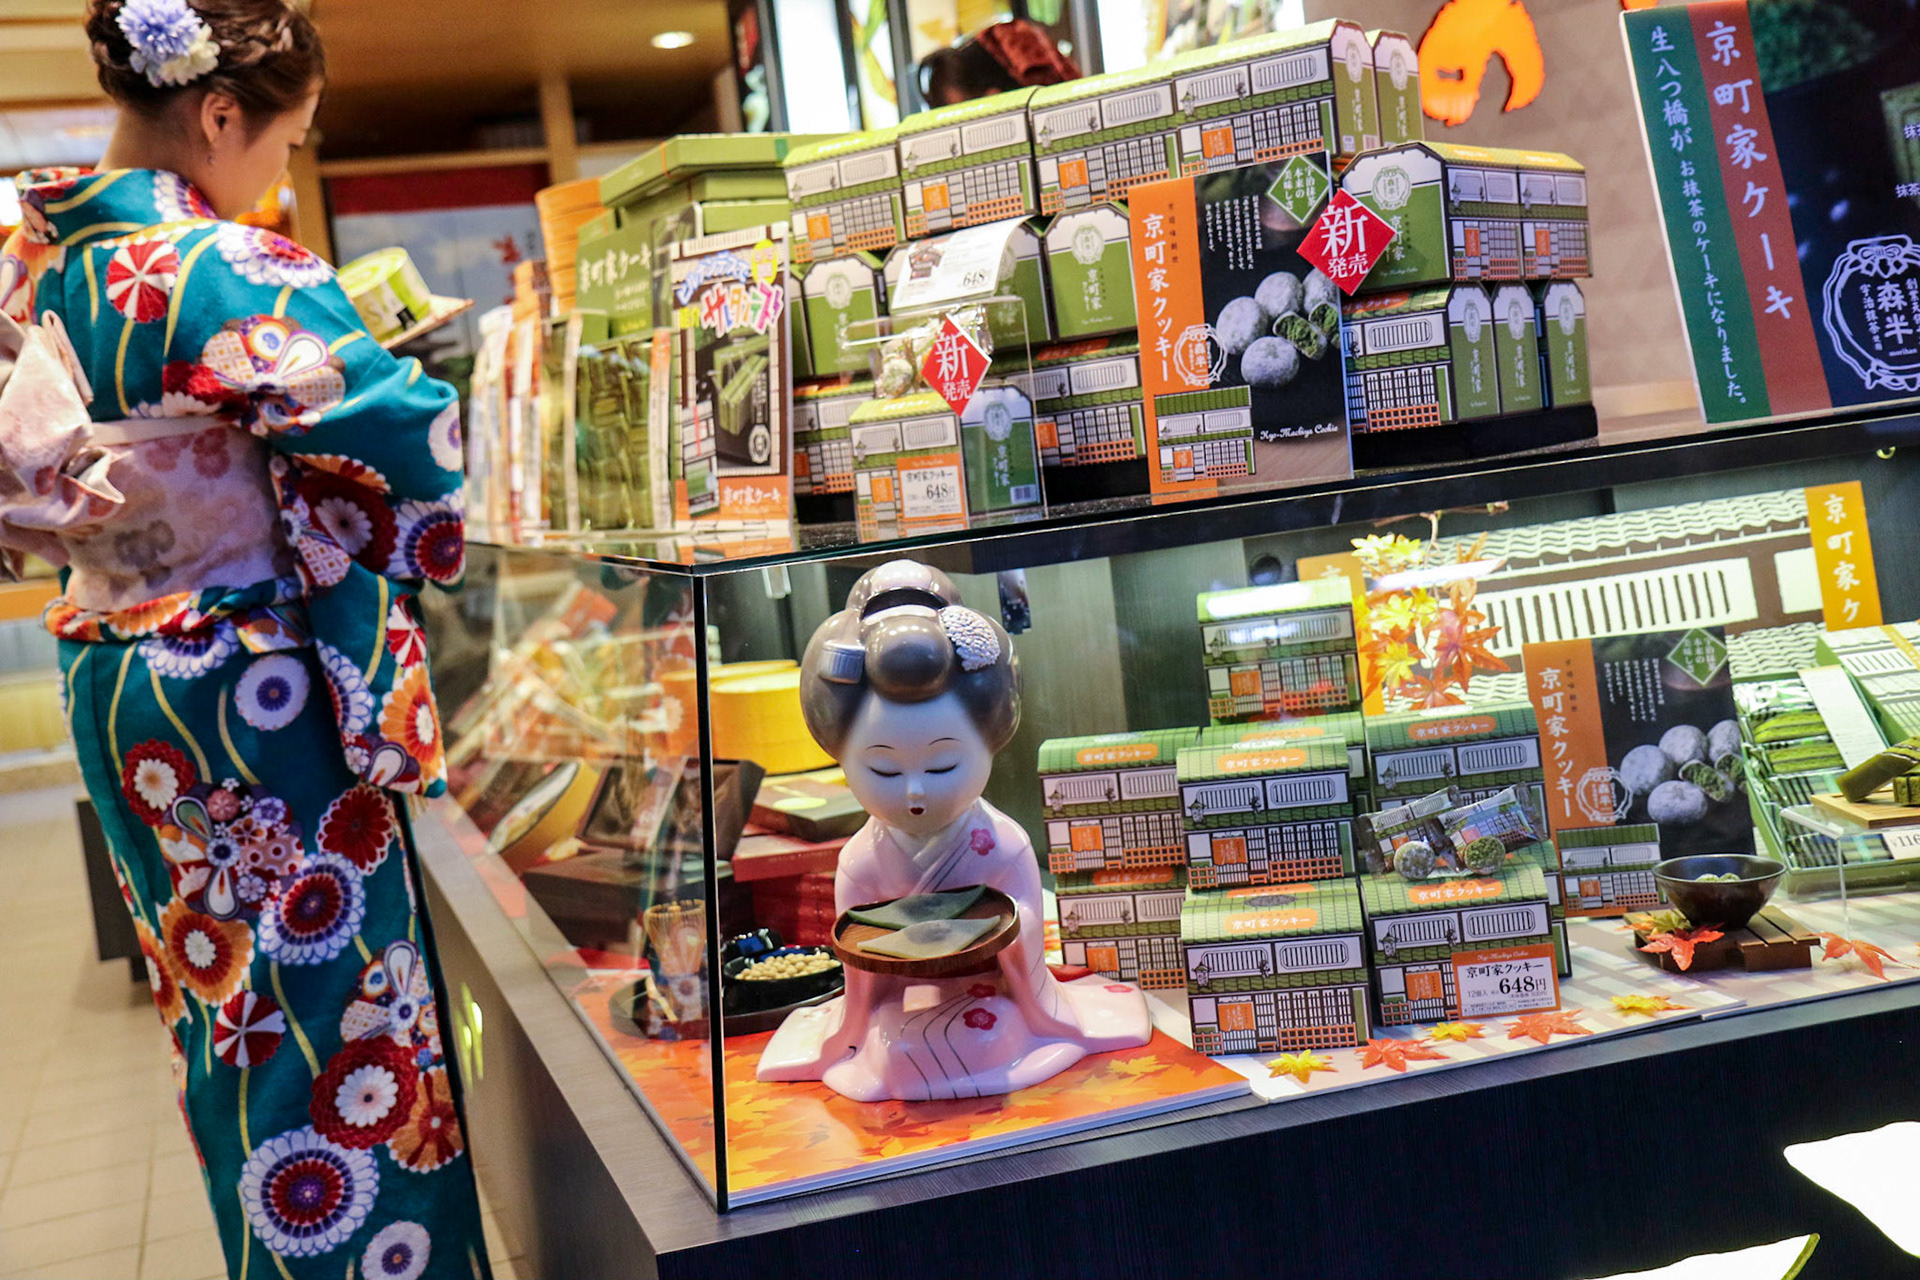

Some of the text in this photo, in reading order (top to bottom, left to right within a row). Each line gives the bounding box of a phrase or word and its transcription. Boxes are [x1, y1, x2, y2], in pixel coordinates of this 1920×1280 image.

[1294, 167, 1305, 198] 本来の
[1706, 20, 1794, 320] 京町家ケーキ
[1319, 204, 1369, 257] 新
[580, 242, 652, 294] 京町家ケーキ
[1327, 253, 1370, 278] 発売
[1142, 213, 1173, 382] 京町家クッキー
[1876, 280, 1913, 344] 森半
[935, 331, 969, 381] 新
[942, 379, 972, 400] 発売
[723, 485, 781, 507] 京町家ケーキ
[1824, 493, 1860, 623] 京町家ケ
[1083, 750, 1153, 763] 京町家クッキー
[1538, 667, 1574, 818] 京町家クッキー
[1225, 755, 1300, 769] 京町家クッキー
[1417, 886, 1496, 901] 京町家クッキー
[1231, 916, 1310, 930] 京町家クッキー
[1466, 961, 1545, 979] 京町家クッキー
[1499, 975, 1547, 995] 648円
